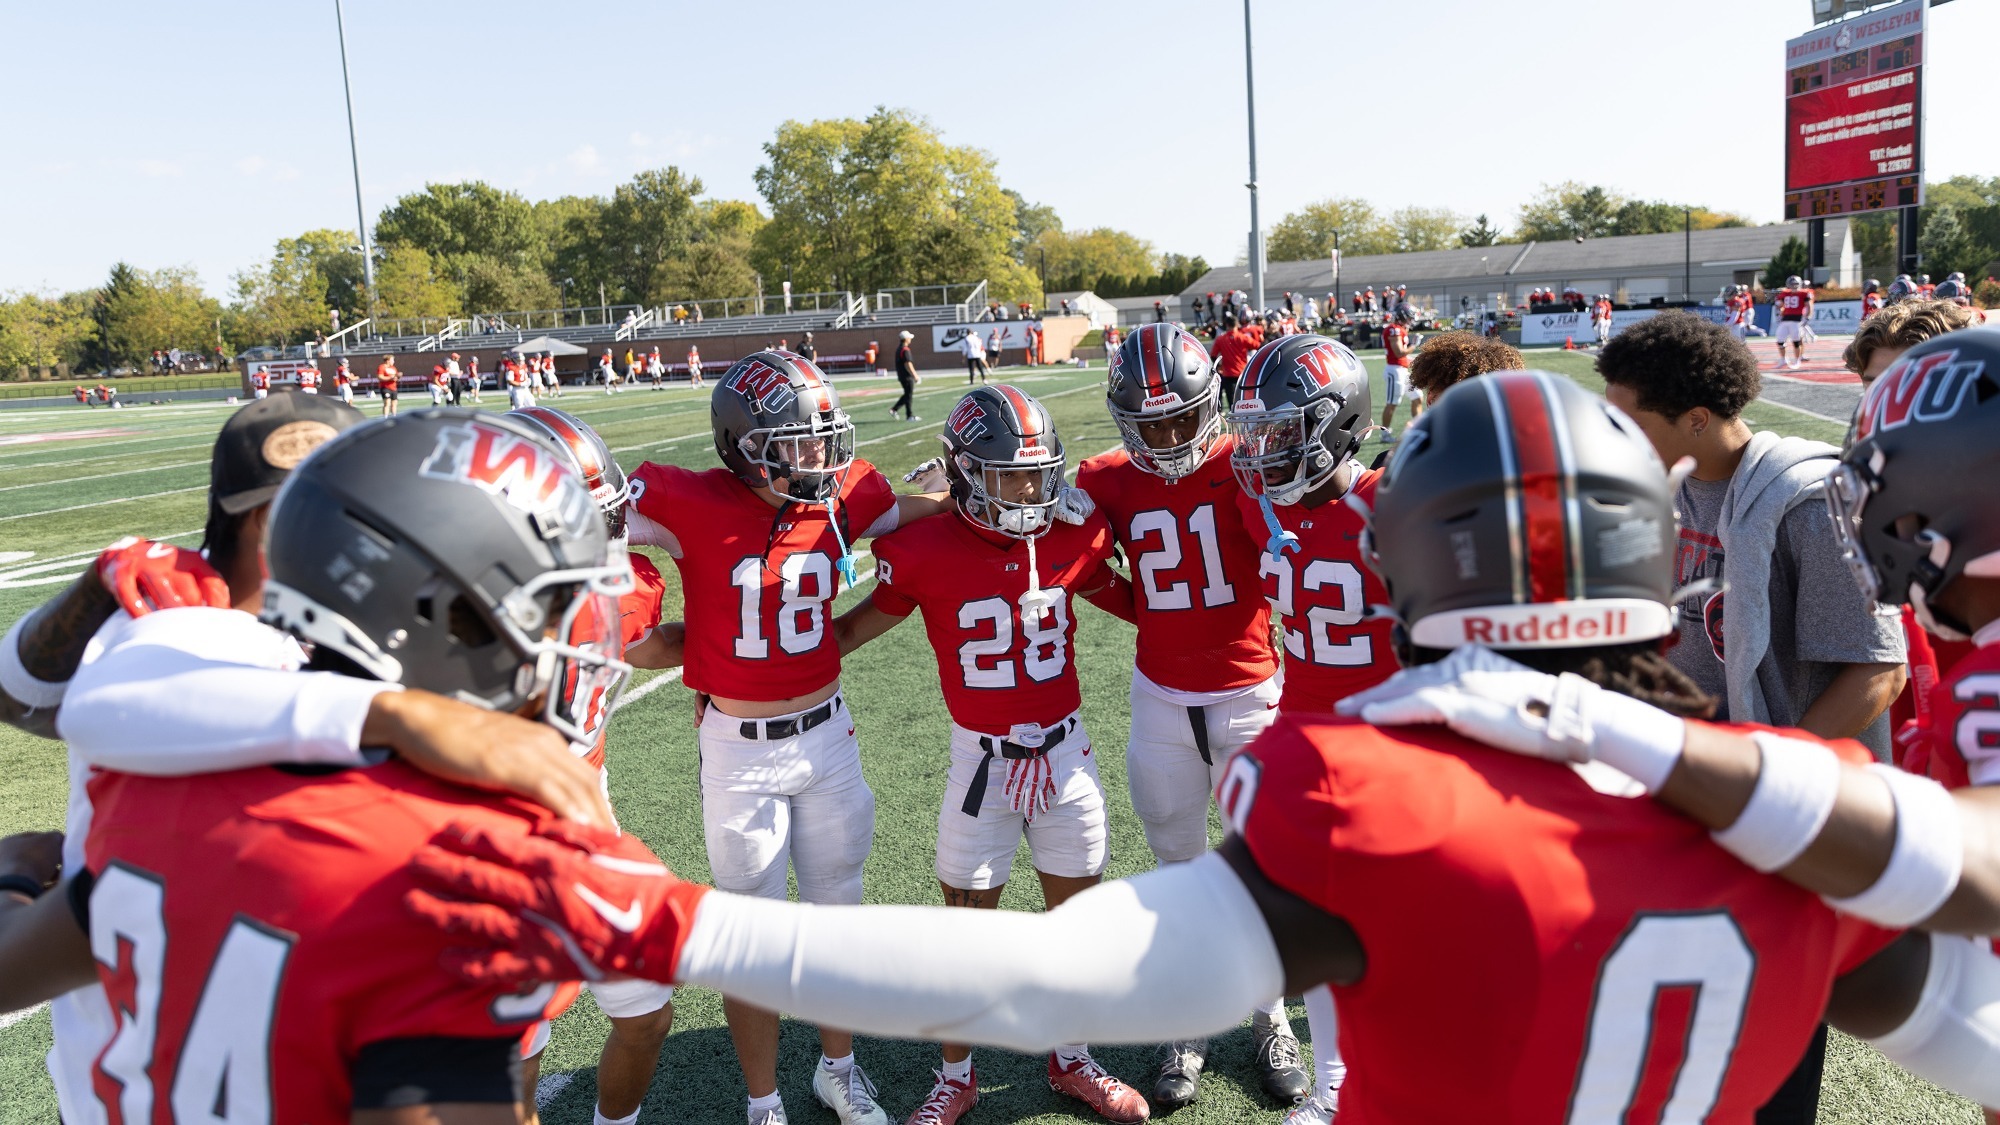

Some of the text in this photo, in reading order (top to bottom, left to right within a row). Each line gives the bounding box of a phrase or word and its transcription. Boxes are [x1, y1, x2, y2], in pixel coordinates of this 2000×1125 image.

[1787, 9, 1921, 60] INDIANA WESLEYAN
[1848, 84, 1861, 98] TEXT
[1805, 115, 1912, 147] text alerts while attending this event
[1806, 122, 1816, 134] you
[1817, 118, 1833, 131] would
[1833, 116, 1845, 128] like
[1853, 109, 1875, 124] receive
[1876, 102, 1912, 119] emergency
[1886, 143, 1912, 158] Football
[1557, 314, 1577, 324] FEAR
[1815, 307, 1850, 320] TAR
[725, 359, 798, 414] IWU
[1293, 342, 1356, 398] IWU
[947, 395, 988, 446] WU
[1145, 395, 1176, 408] Riddell
[1855, 350, 1985, 443] WU
[1020, 449, 1047, 457] Riddell
[1129, 503, 1236, 612] 21
[1679, 544, 1725, 587] CAT
[730, 550, 833, 660] 18
[1259, 550, 1374, 667] 22
[1461, 611, 1628, 645] Riddell
[956, 585, 1069, 689] 28
[90, 858, 300, 1125] 34
[1565, 907, 1756, 1125] 0
